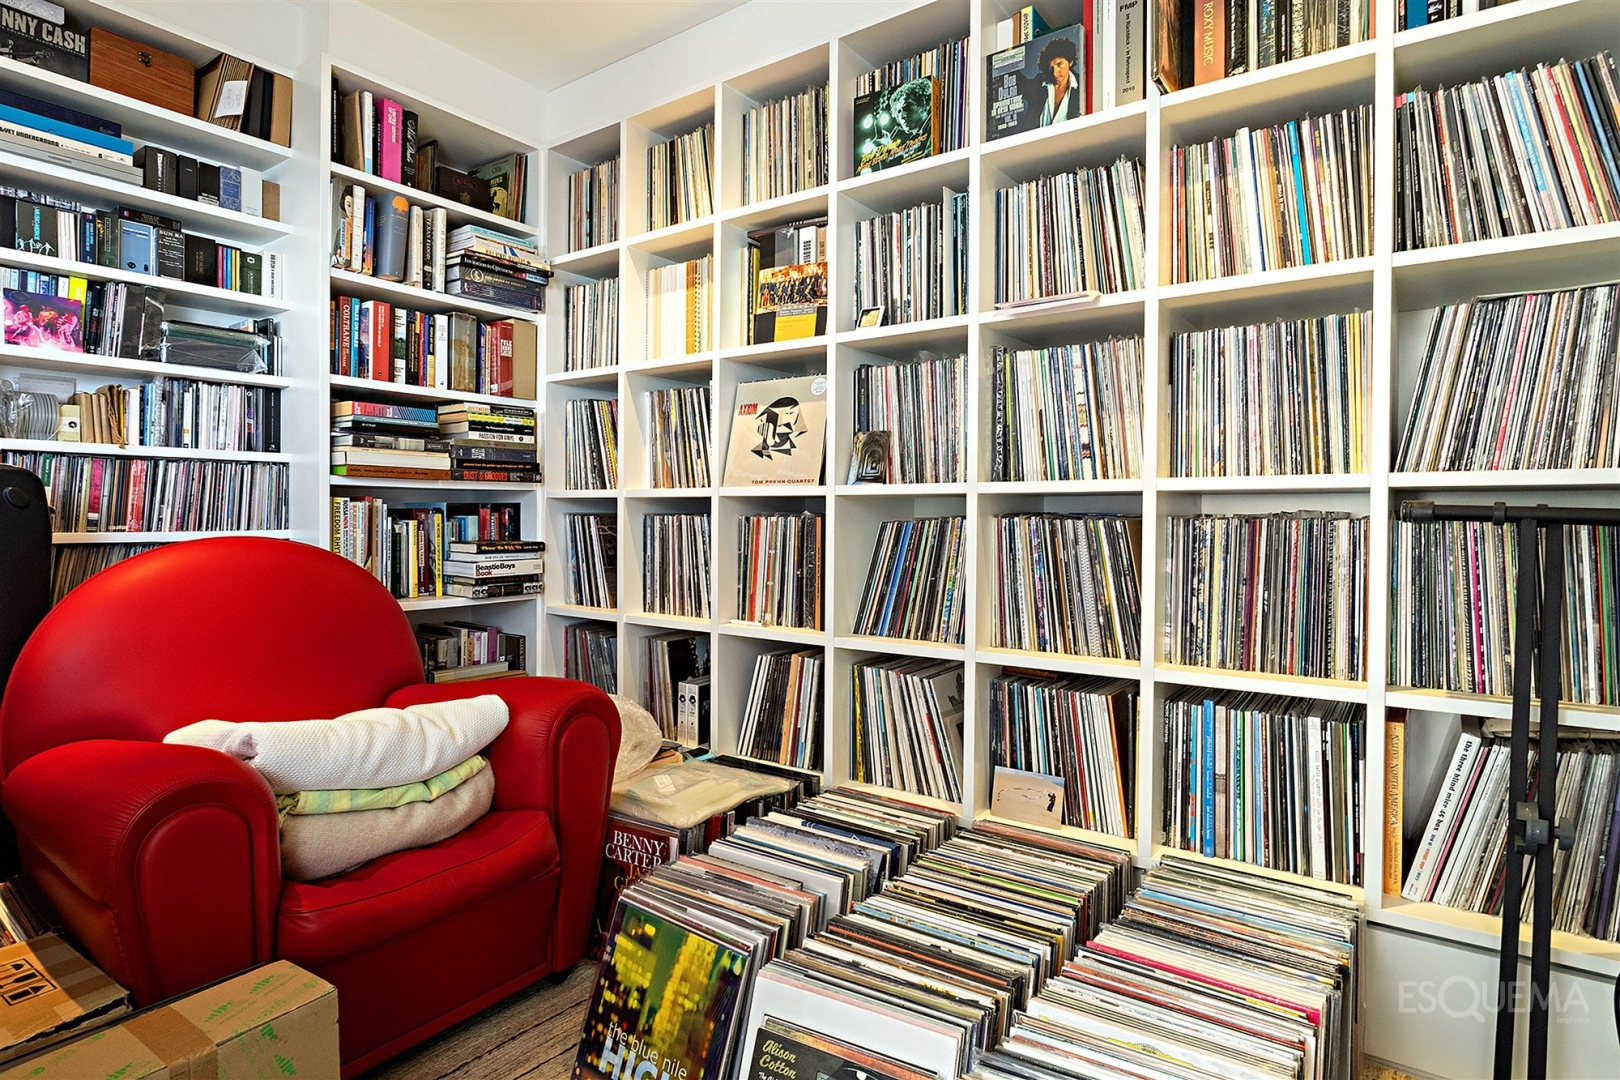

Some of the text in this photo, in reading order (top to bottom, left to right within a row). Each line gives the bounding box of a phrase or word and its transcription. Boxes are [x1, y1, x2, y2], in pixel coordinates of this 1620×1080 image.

[1119, 1, 1138, 12] FMP
[1126, 12, 1131, 20] Im
[42, 22, 86, 54] CASH
[1203, 1, 1214, 66] ROXY MUSIC
[1122, 85, 1136, 94] 2010
[16, 131, 60, 147] UNDERGROUND
[406, 120, 416, 163] Nick Drake
[464, 257, 486, 268] Invitation
[491, 264, 513, 274] Openness
[354, 322, 359, 330] ON
[738, 403, 758, 416] AXIOM
[463, 471, 478, 480] DUST
[484, 472, 508, 481] GROOVES
[1390, 764, 1399, 789] NORTH
[1433, 740, 1473, 832] the three blind mice 45 box
[1389, 791, 1398, 826] AMERICA
[612, 830, 664, 856] BENNY
[608, 1022, 688, 1079] the blue nile
[762, 1039, 796, 1063] Alison
[759, 1054, 797, 1079] Cotton
